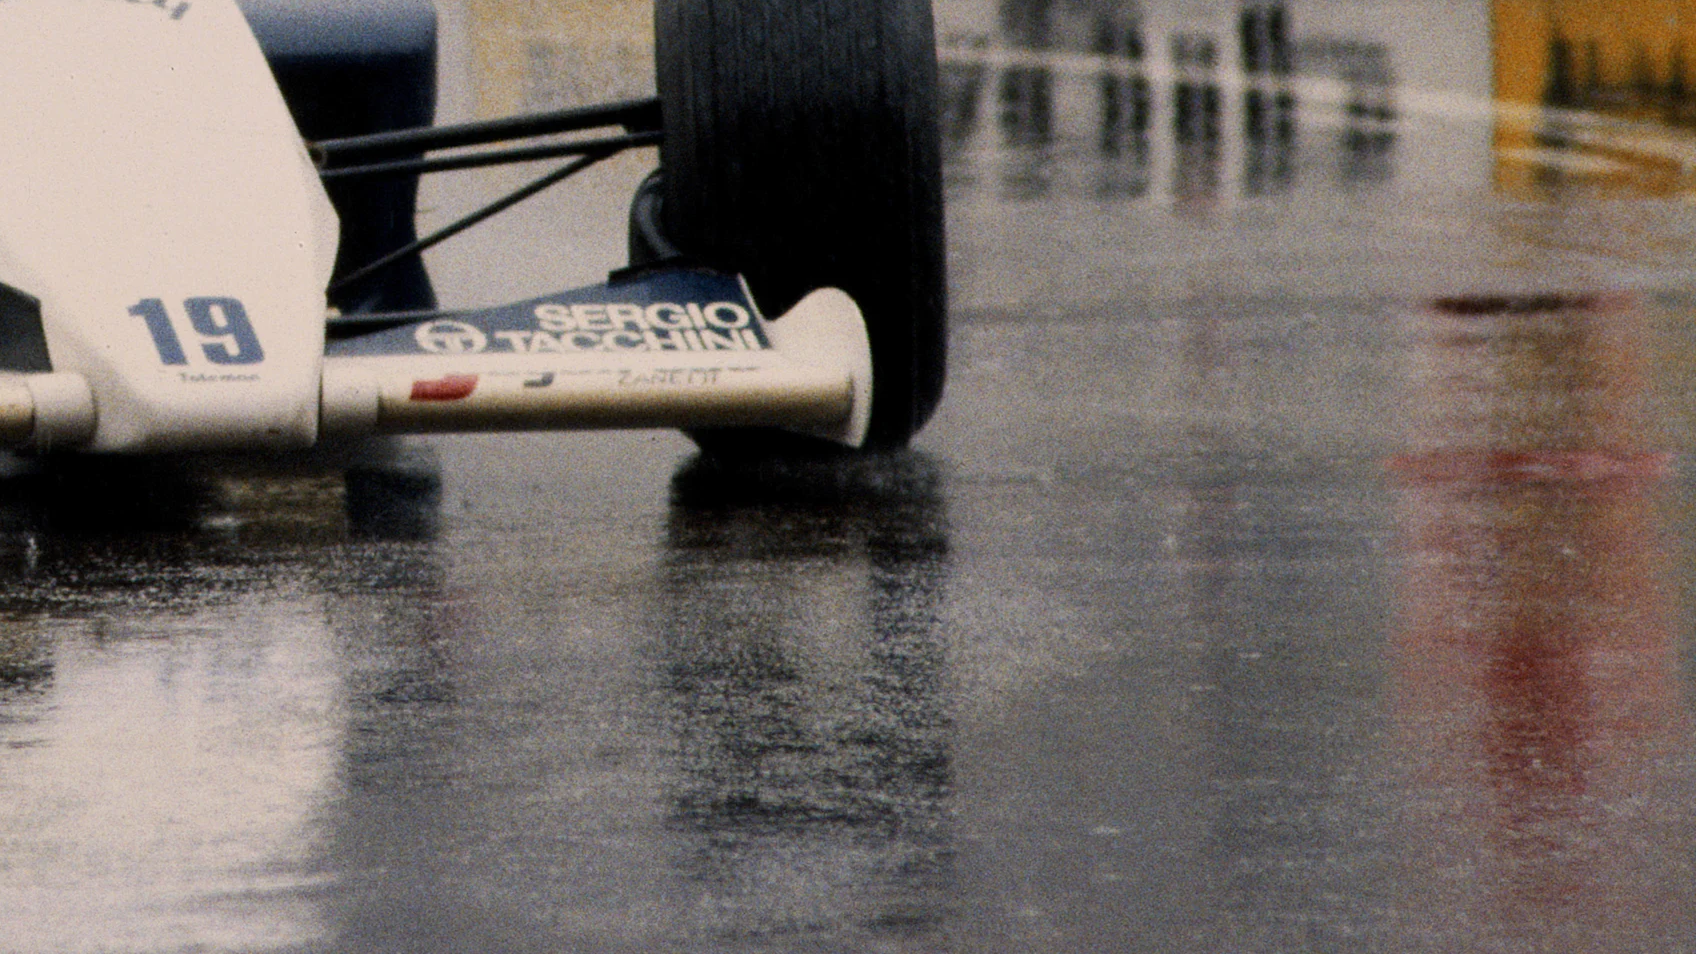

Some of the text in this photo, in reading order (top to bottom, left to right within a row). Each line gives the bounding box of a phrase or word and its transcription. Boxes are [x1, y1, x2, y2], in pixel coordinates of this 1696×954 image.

[534, 302, 750, 331] SERGIO
[127, 297, 265, 366] 19
[494, 328, 764, 352] TACCHINI
